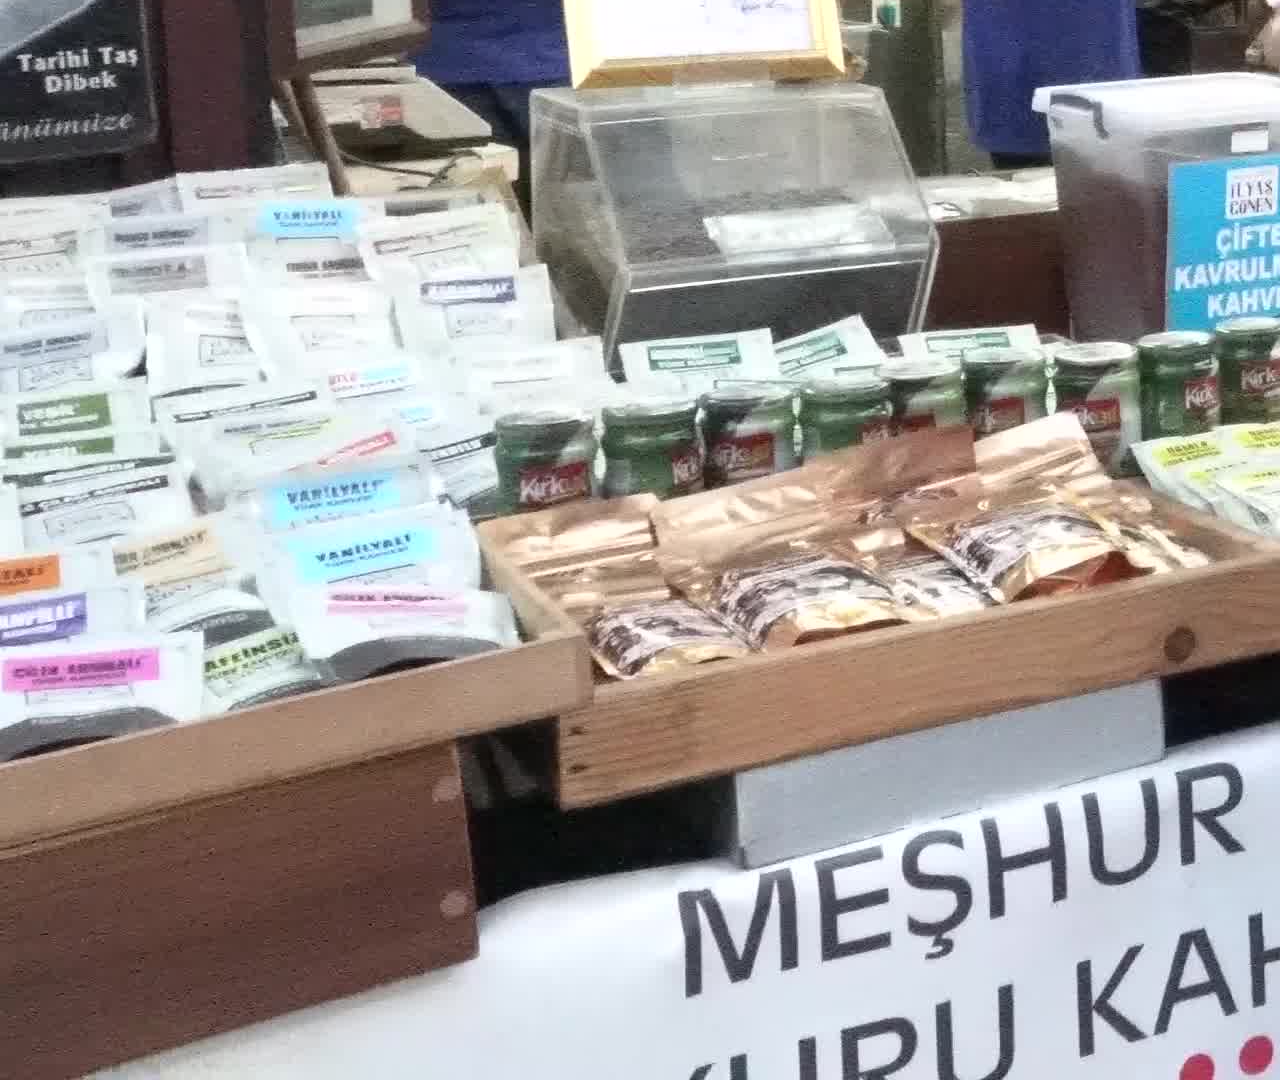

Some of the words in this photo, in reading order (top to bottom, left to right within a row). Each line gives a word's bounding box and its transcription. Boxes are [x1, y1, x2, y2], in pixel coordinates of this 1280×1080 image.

[17, 48, 90, 72] Tarihi
[99, 46, 138, 67] Taş
[45, 71, 117, 93] Dibek
[680, 762, 1246, 998] MEŞHUR
